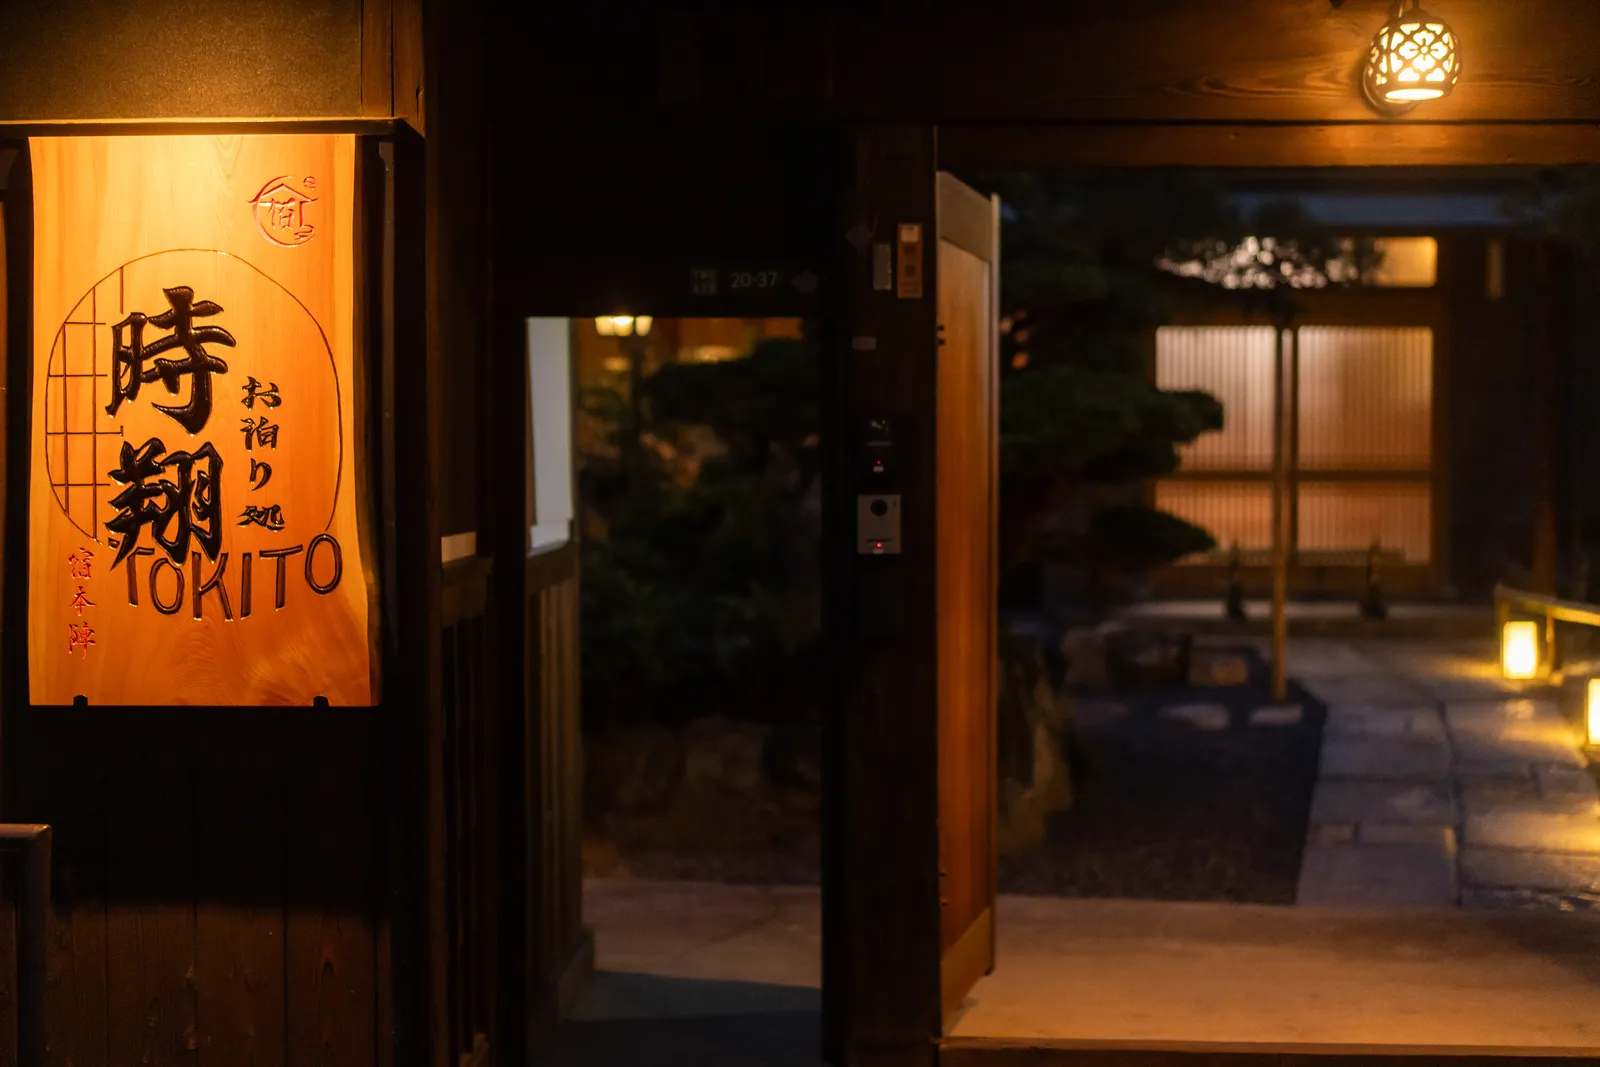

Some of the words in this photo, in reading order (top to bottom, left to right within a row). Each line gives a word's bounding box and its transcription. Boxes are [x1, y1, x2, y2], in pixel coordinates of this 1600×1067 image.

[730, 271, 778, 289] 20-37
[105, 286, 236, 570] 時翔
[238, 376, 285, 531] お泊り処
[68, 547, 96, 660] 宿本陣
[109, 534, 343, 621] TOKITO
